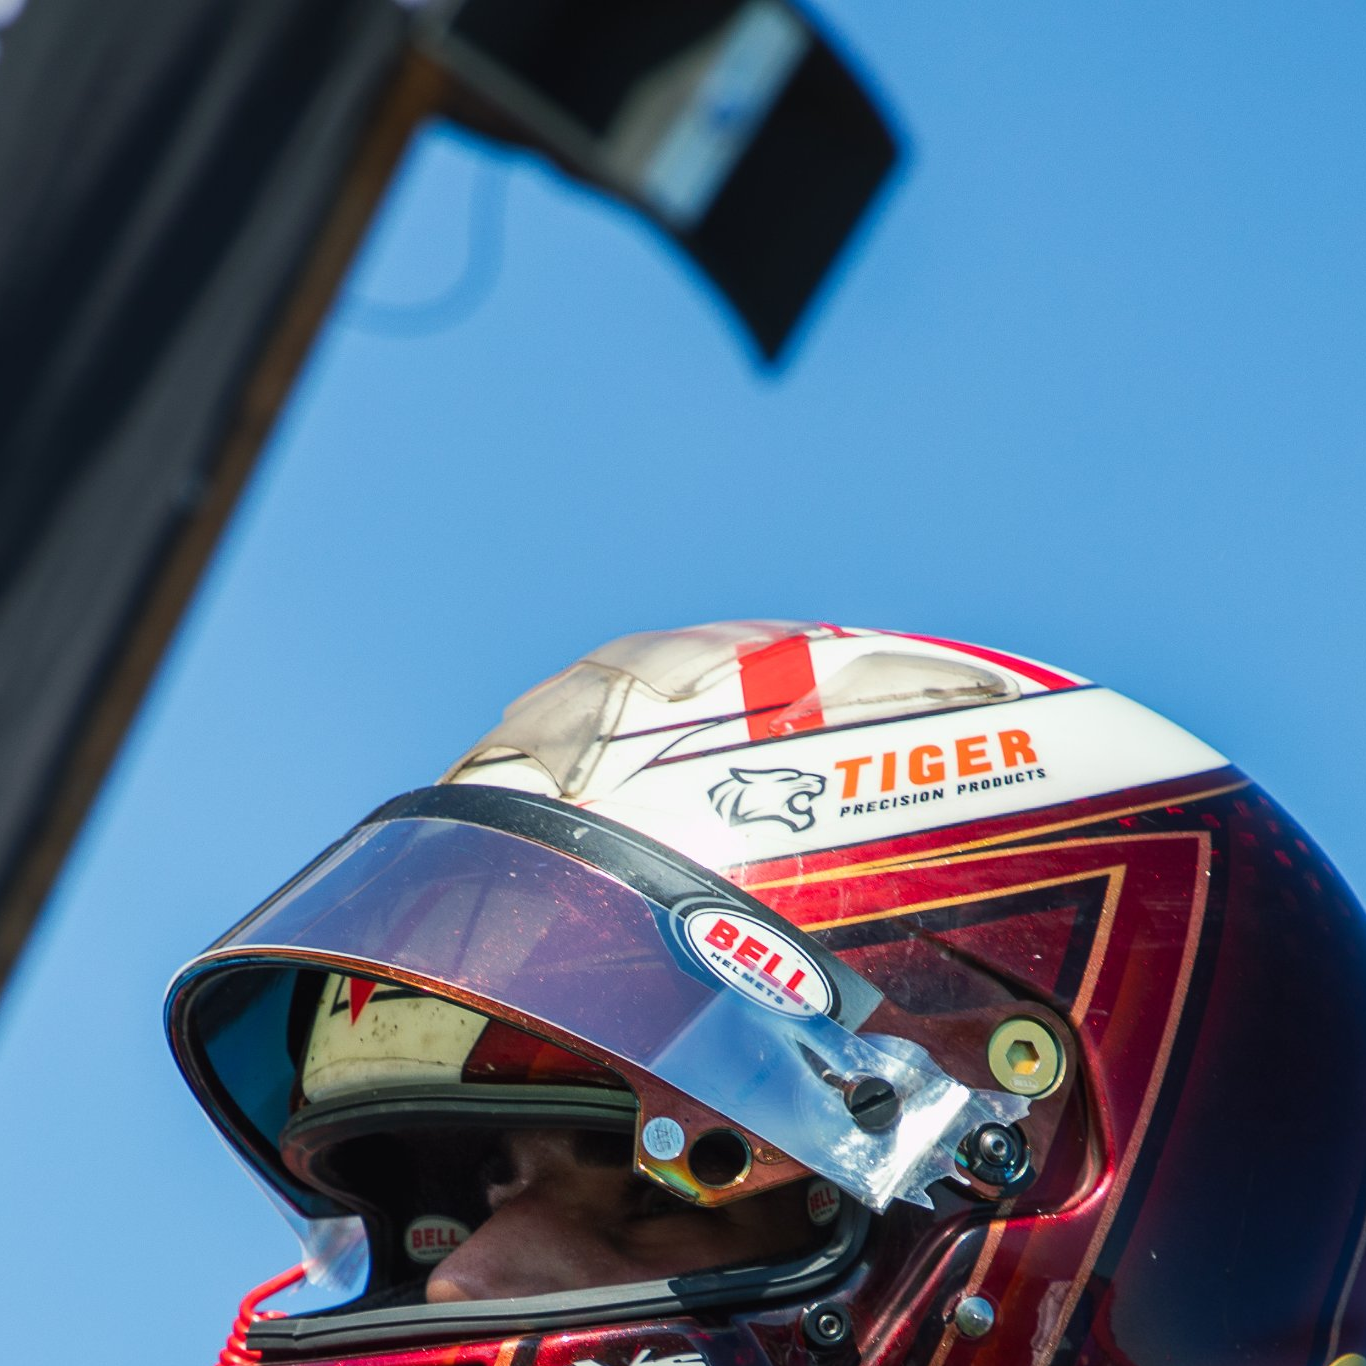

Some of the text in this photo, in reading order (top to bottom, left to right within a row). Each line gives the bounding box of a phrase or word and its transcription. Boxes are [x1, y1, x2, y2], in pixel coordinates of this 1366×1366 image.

[834, 729, 1038, 799] TIGER
[840, 768, 1046, 817] PRECISION PRODUCTS
[704, 918, 806, 1006] BELL
[711, 951, 784, 1004] HELMETS
[411, 1228, 461, 1248] BELL
